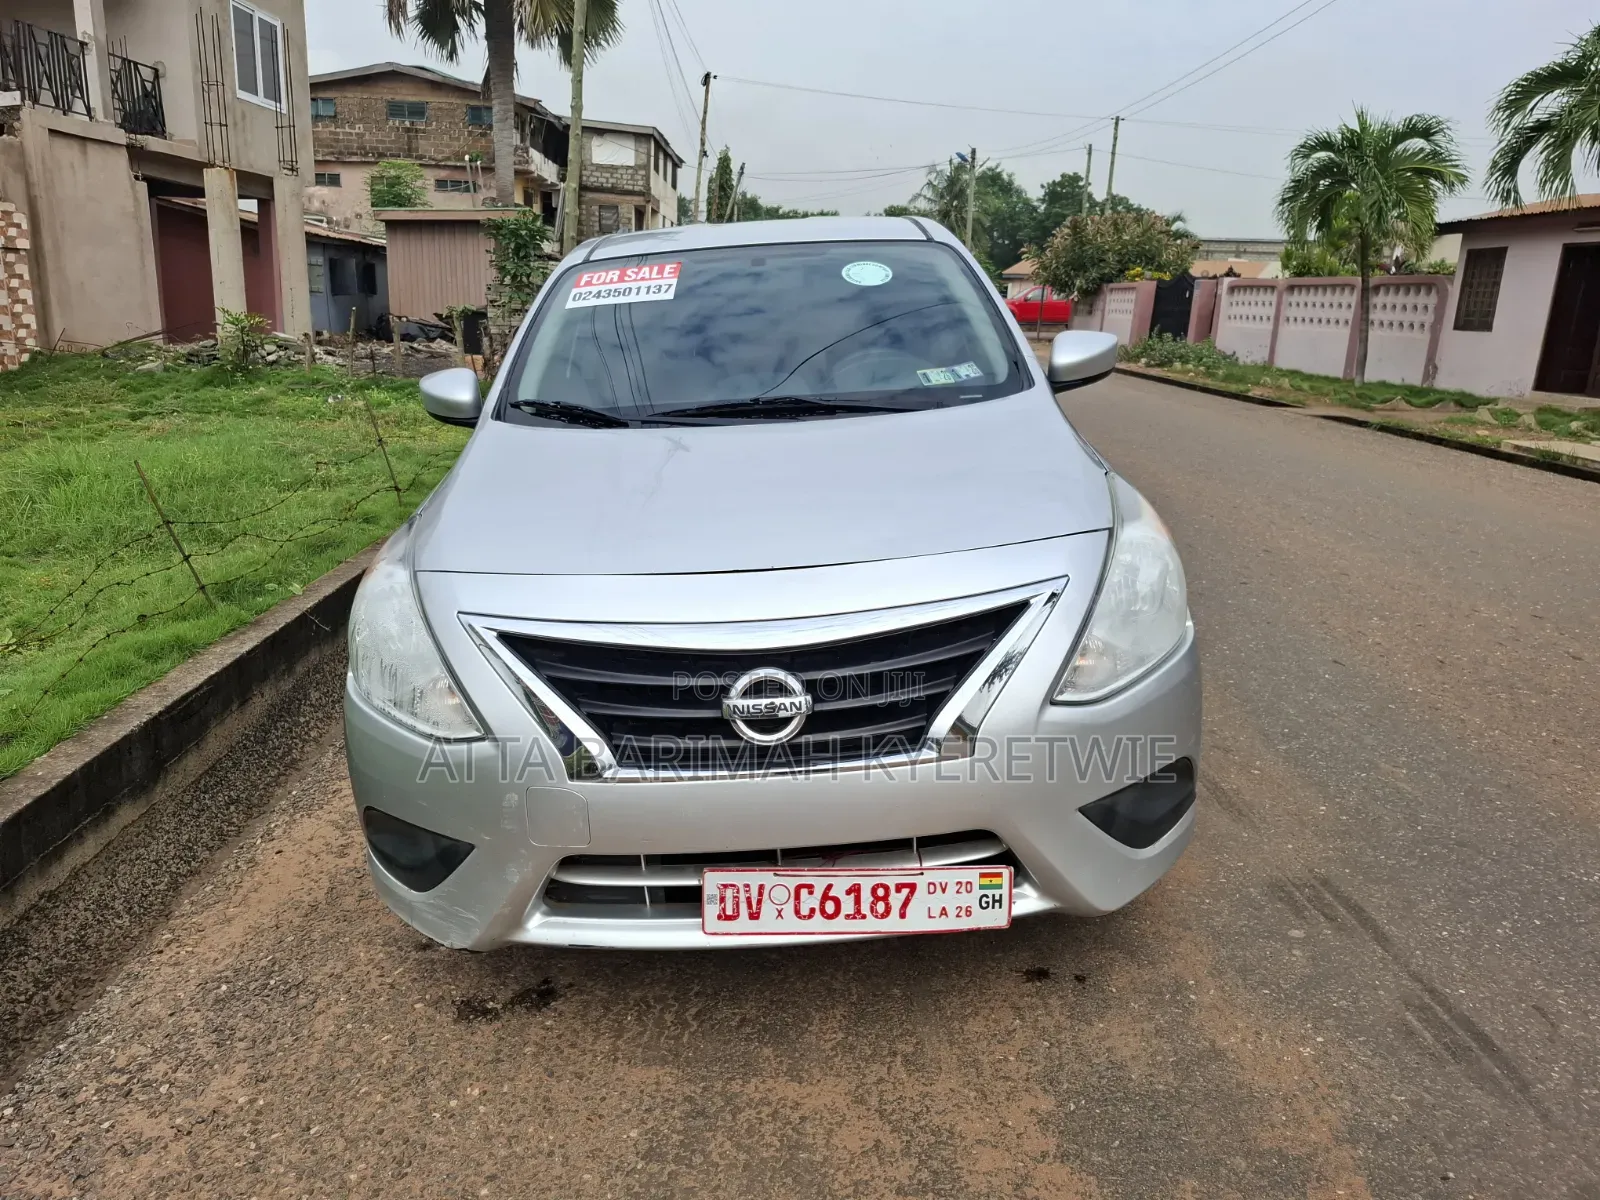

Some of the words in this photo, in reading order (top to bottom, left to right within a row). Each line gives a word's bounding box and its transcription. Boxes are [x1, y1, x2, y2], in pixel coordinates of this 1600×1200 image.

[580, 270, 620, 286] FOR
[624, 264, 677, 281] SALE
[572, 284, 673, 302] 0243501137
[732, 701, 803, 715] NISSAN
[927, 881, 949, 895] DV
[955, 880, 973, 894] 20
[716, 883, 765, 921] DV
[793, 882, 918, 921] C6187
[978, 893, 1003, 910] GH
[775, 907, 784, 920] X
[927, 905, 949, 919] LA
[955, 904, 973, 918] 26
